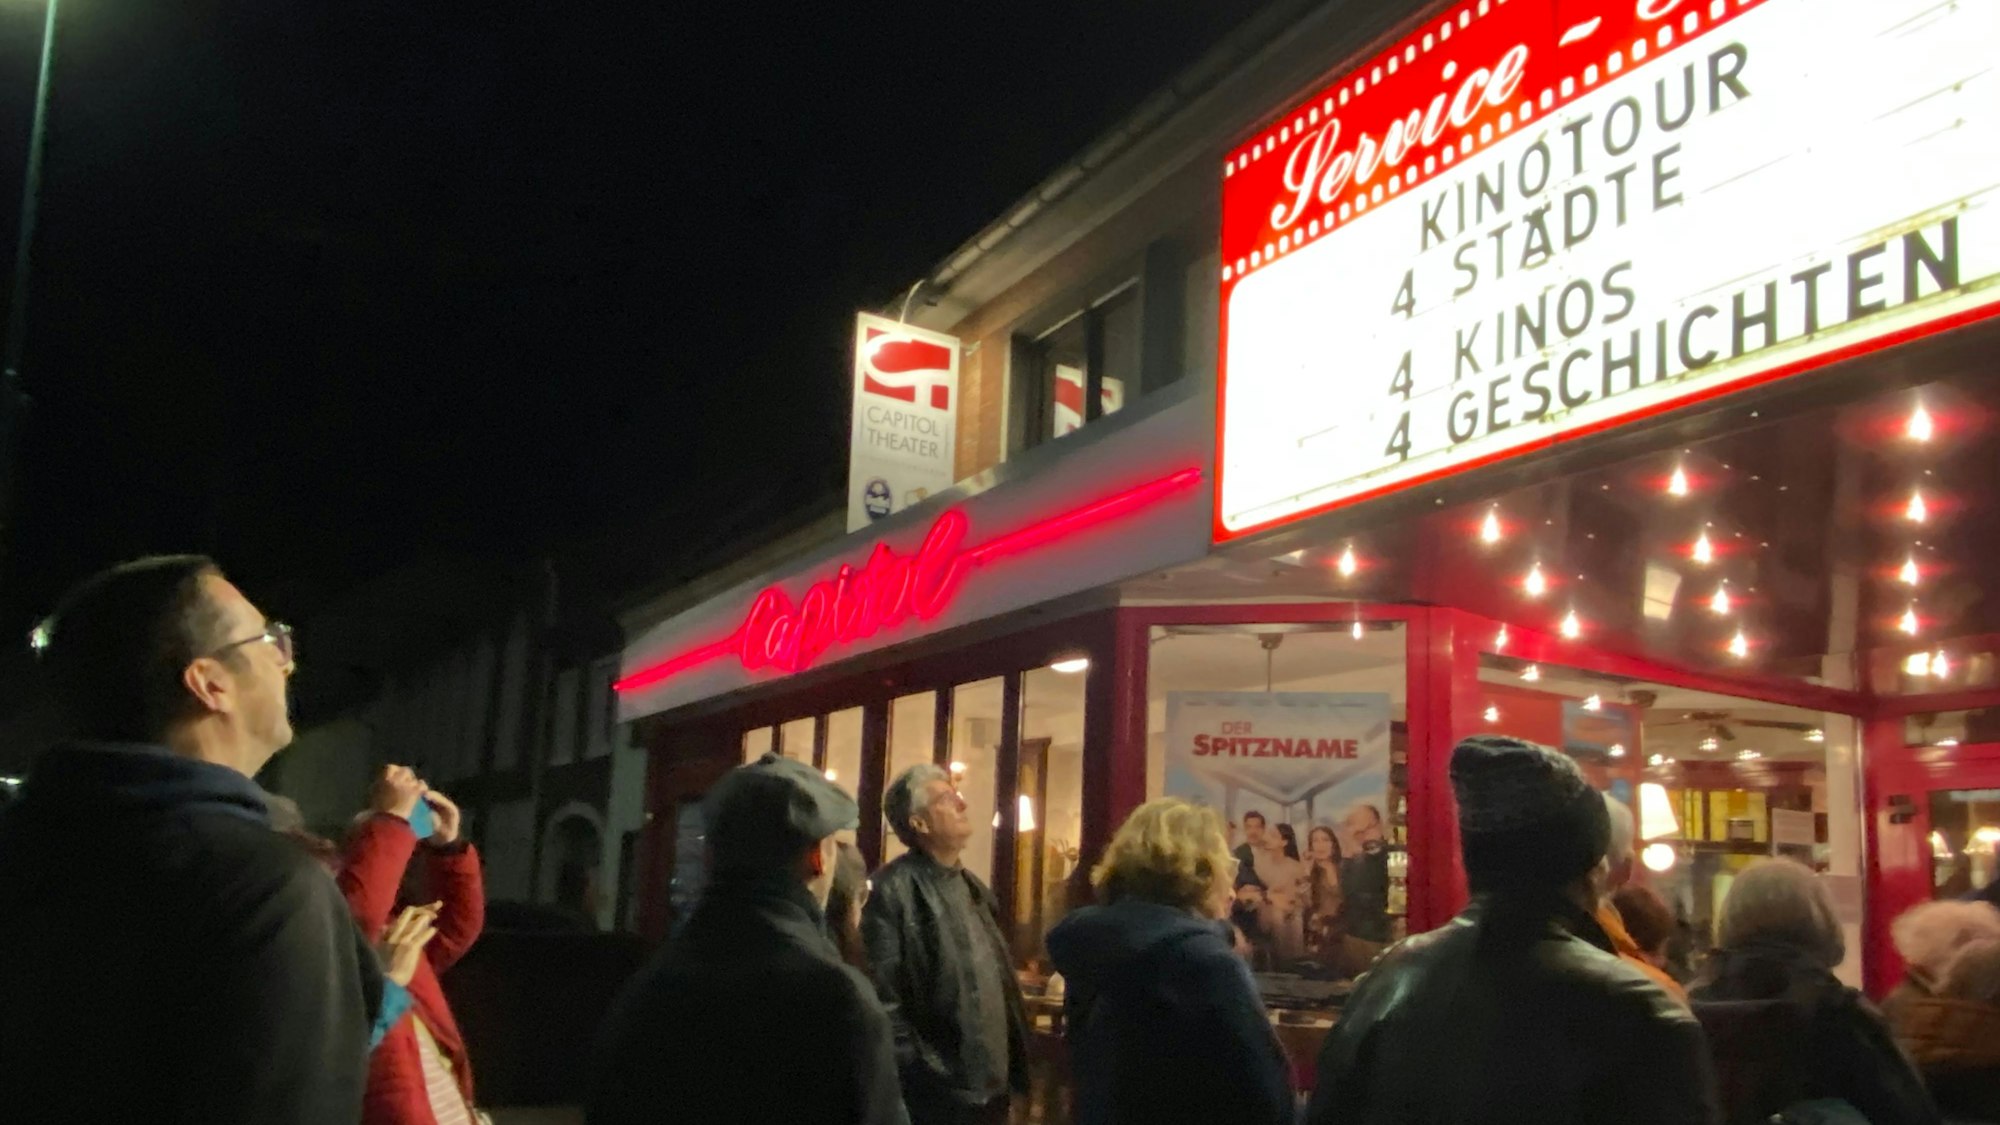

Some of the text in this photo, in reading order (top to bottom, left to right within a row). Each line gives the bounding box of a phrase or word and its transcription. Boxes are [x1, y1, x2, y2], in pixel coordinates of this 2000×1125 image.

[1270, 43, 1529, 230] Service
[1419, 41, 1752, 252] KINOTOUR
[1390, 142, 1684, 319] 4 STÄDTE
[1384, 216, 1960, 462] 4 GESCHICHTEN
[1388, 260, 1636, 401] 4 KINOS
[867, 405, 939, 436] CAPITOL
[867, 427, 939, 458] THEATER
[738, 510, 968, 672] Capitol
[1192, 733, 1359, 760] SPITZNAME
[1221, 721, 1253, 735] DER
